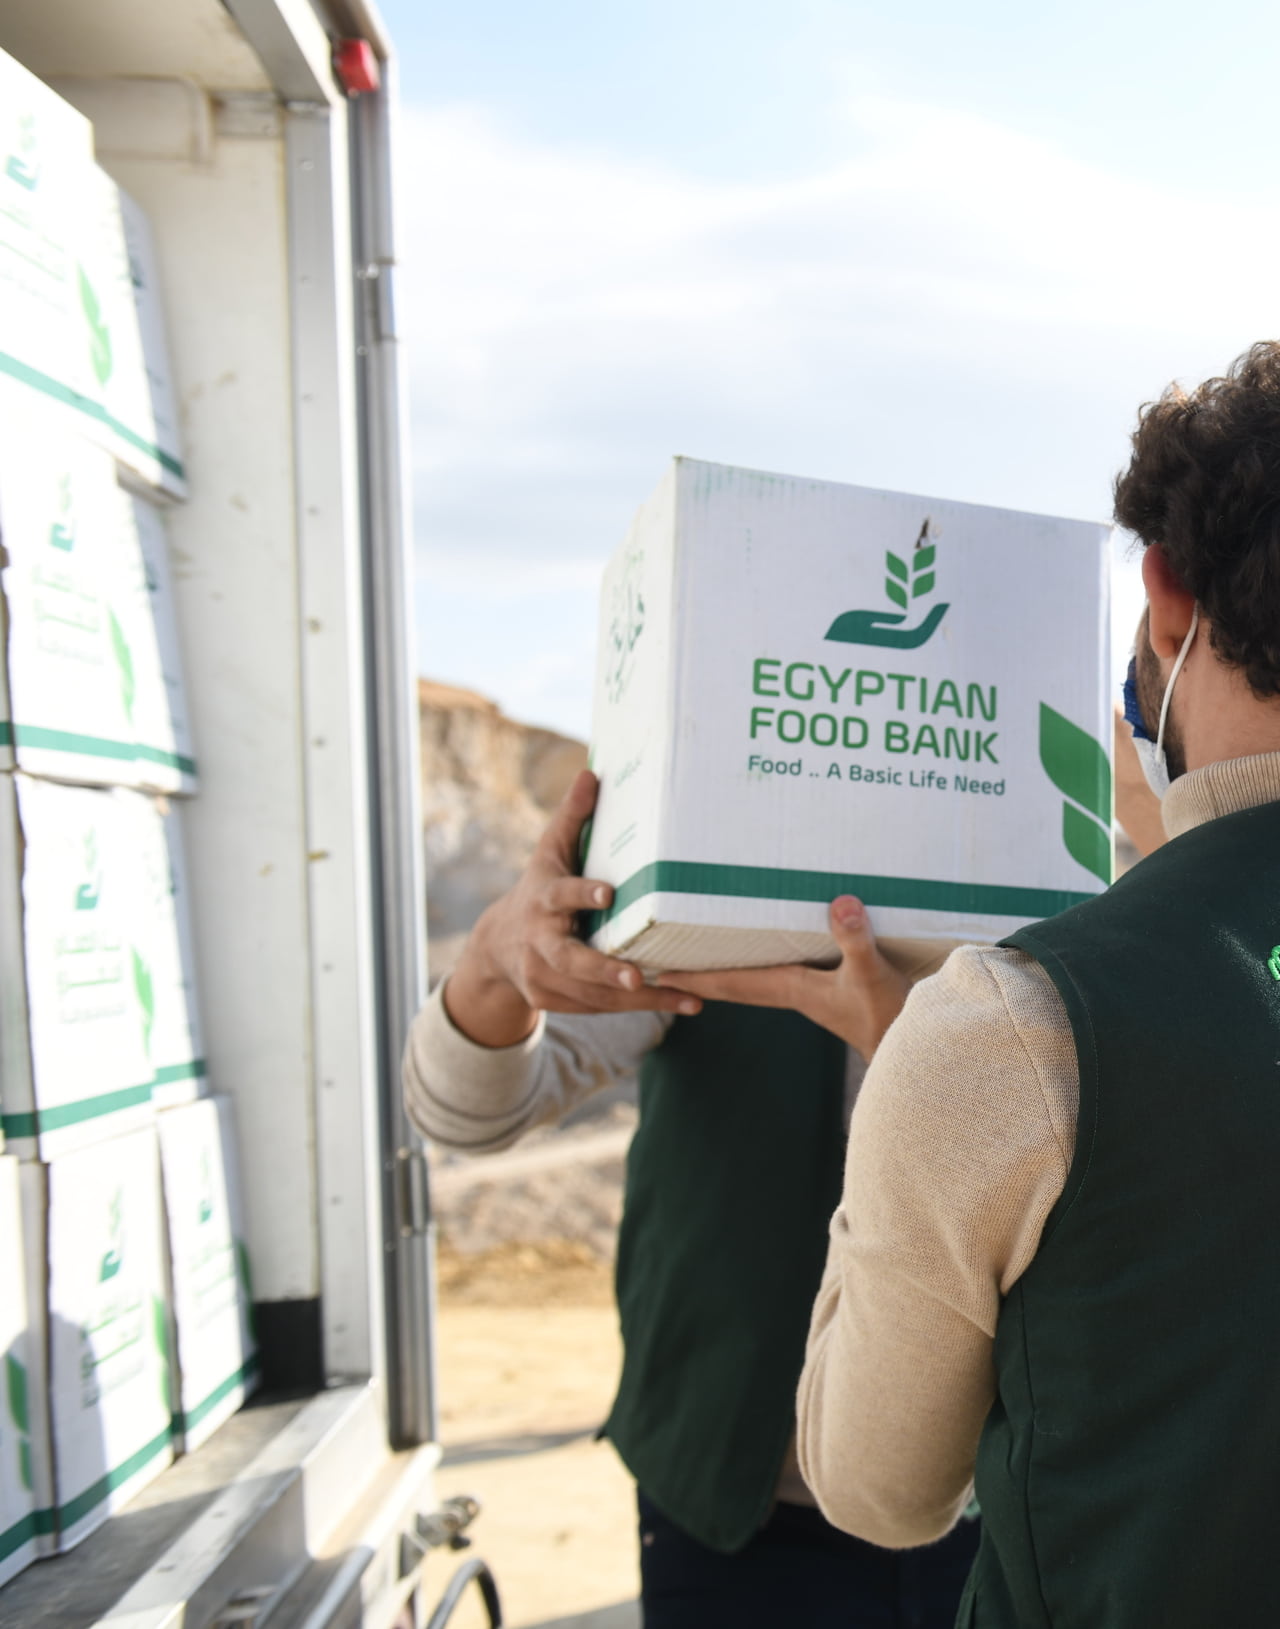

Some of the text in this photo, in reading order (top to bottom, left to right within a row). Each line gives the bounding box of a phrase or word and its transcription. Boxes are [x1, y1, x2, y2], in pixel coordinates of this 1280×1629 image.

[752, 658, 997, 721] EGYPTIAN
[750, 706, 999, 764] FOOD BANK
[748, 755, 802, 776] Food
[827, 763, 842, 779] A
[849, 765, 903, 786] Basic
[909, 770, 948, 791] Life
[954, 775, 1006, 796] Need
